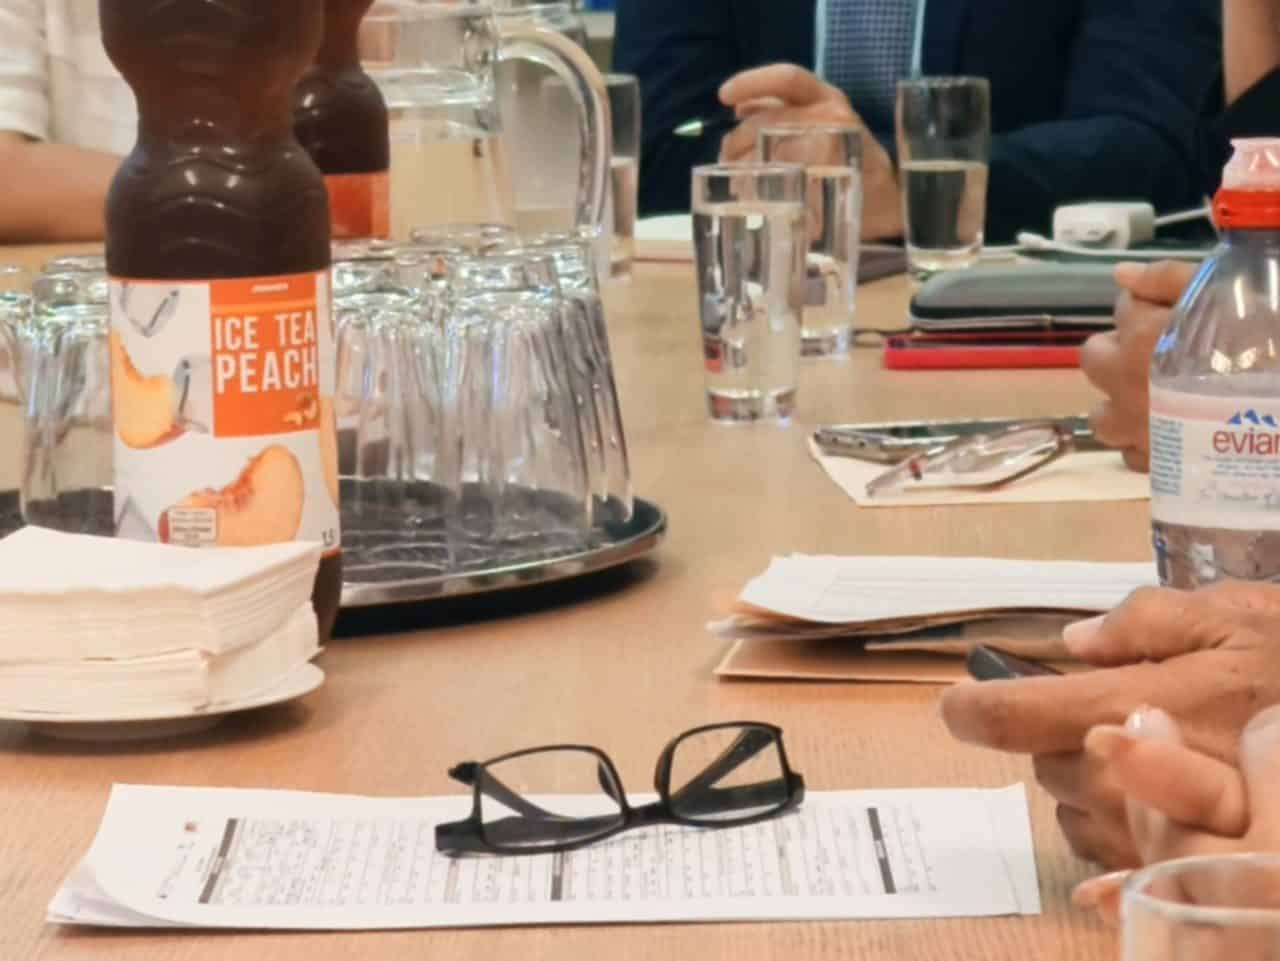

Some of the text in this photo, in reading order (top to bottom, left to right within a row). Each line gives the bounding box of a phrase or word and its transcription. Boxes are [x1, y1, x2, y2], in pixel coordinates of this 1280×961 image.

[214, 309, 316, 351] ICE TEA
[215, 346, 318, 395] PEACH
